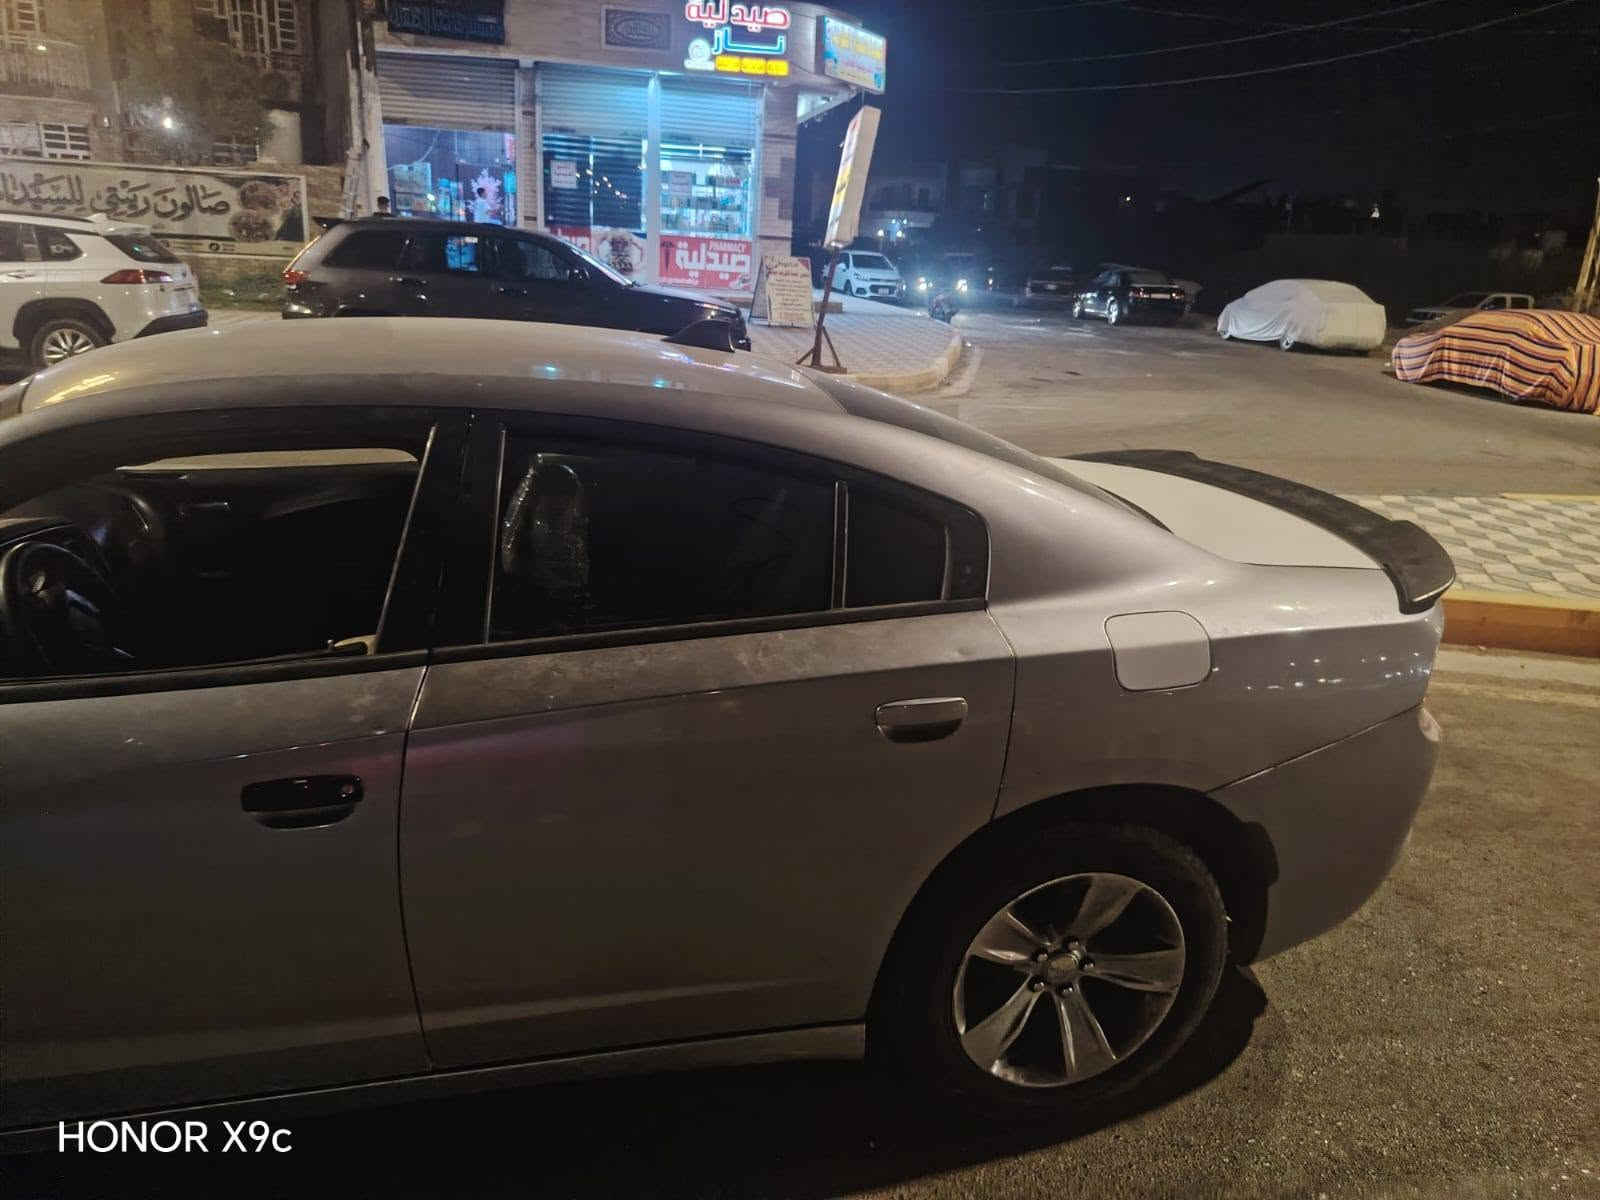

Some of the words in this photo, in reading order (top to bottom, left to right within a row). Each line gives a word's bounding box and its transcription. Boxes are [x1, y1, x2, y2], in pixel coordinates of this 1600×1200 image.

[0, 172, 86, 212] للسيدا
[152, 183, 231, 222] صالون
[675, 240, 751, 281] صيدلية
